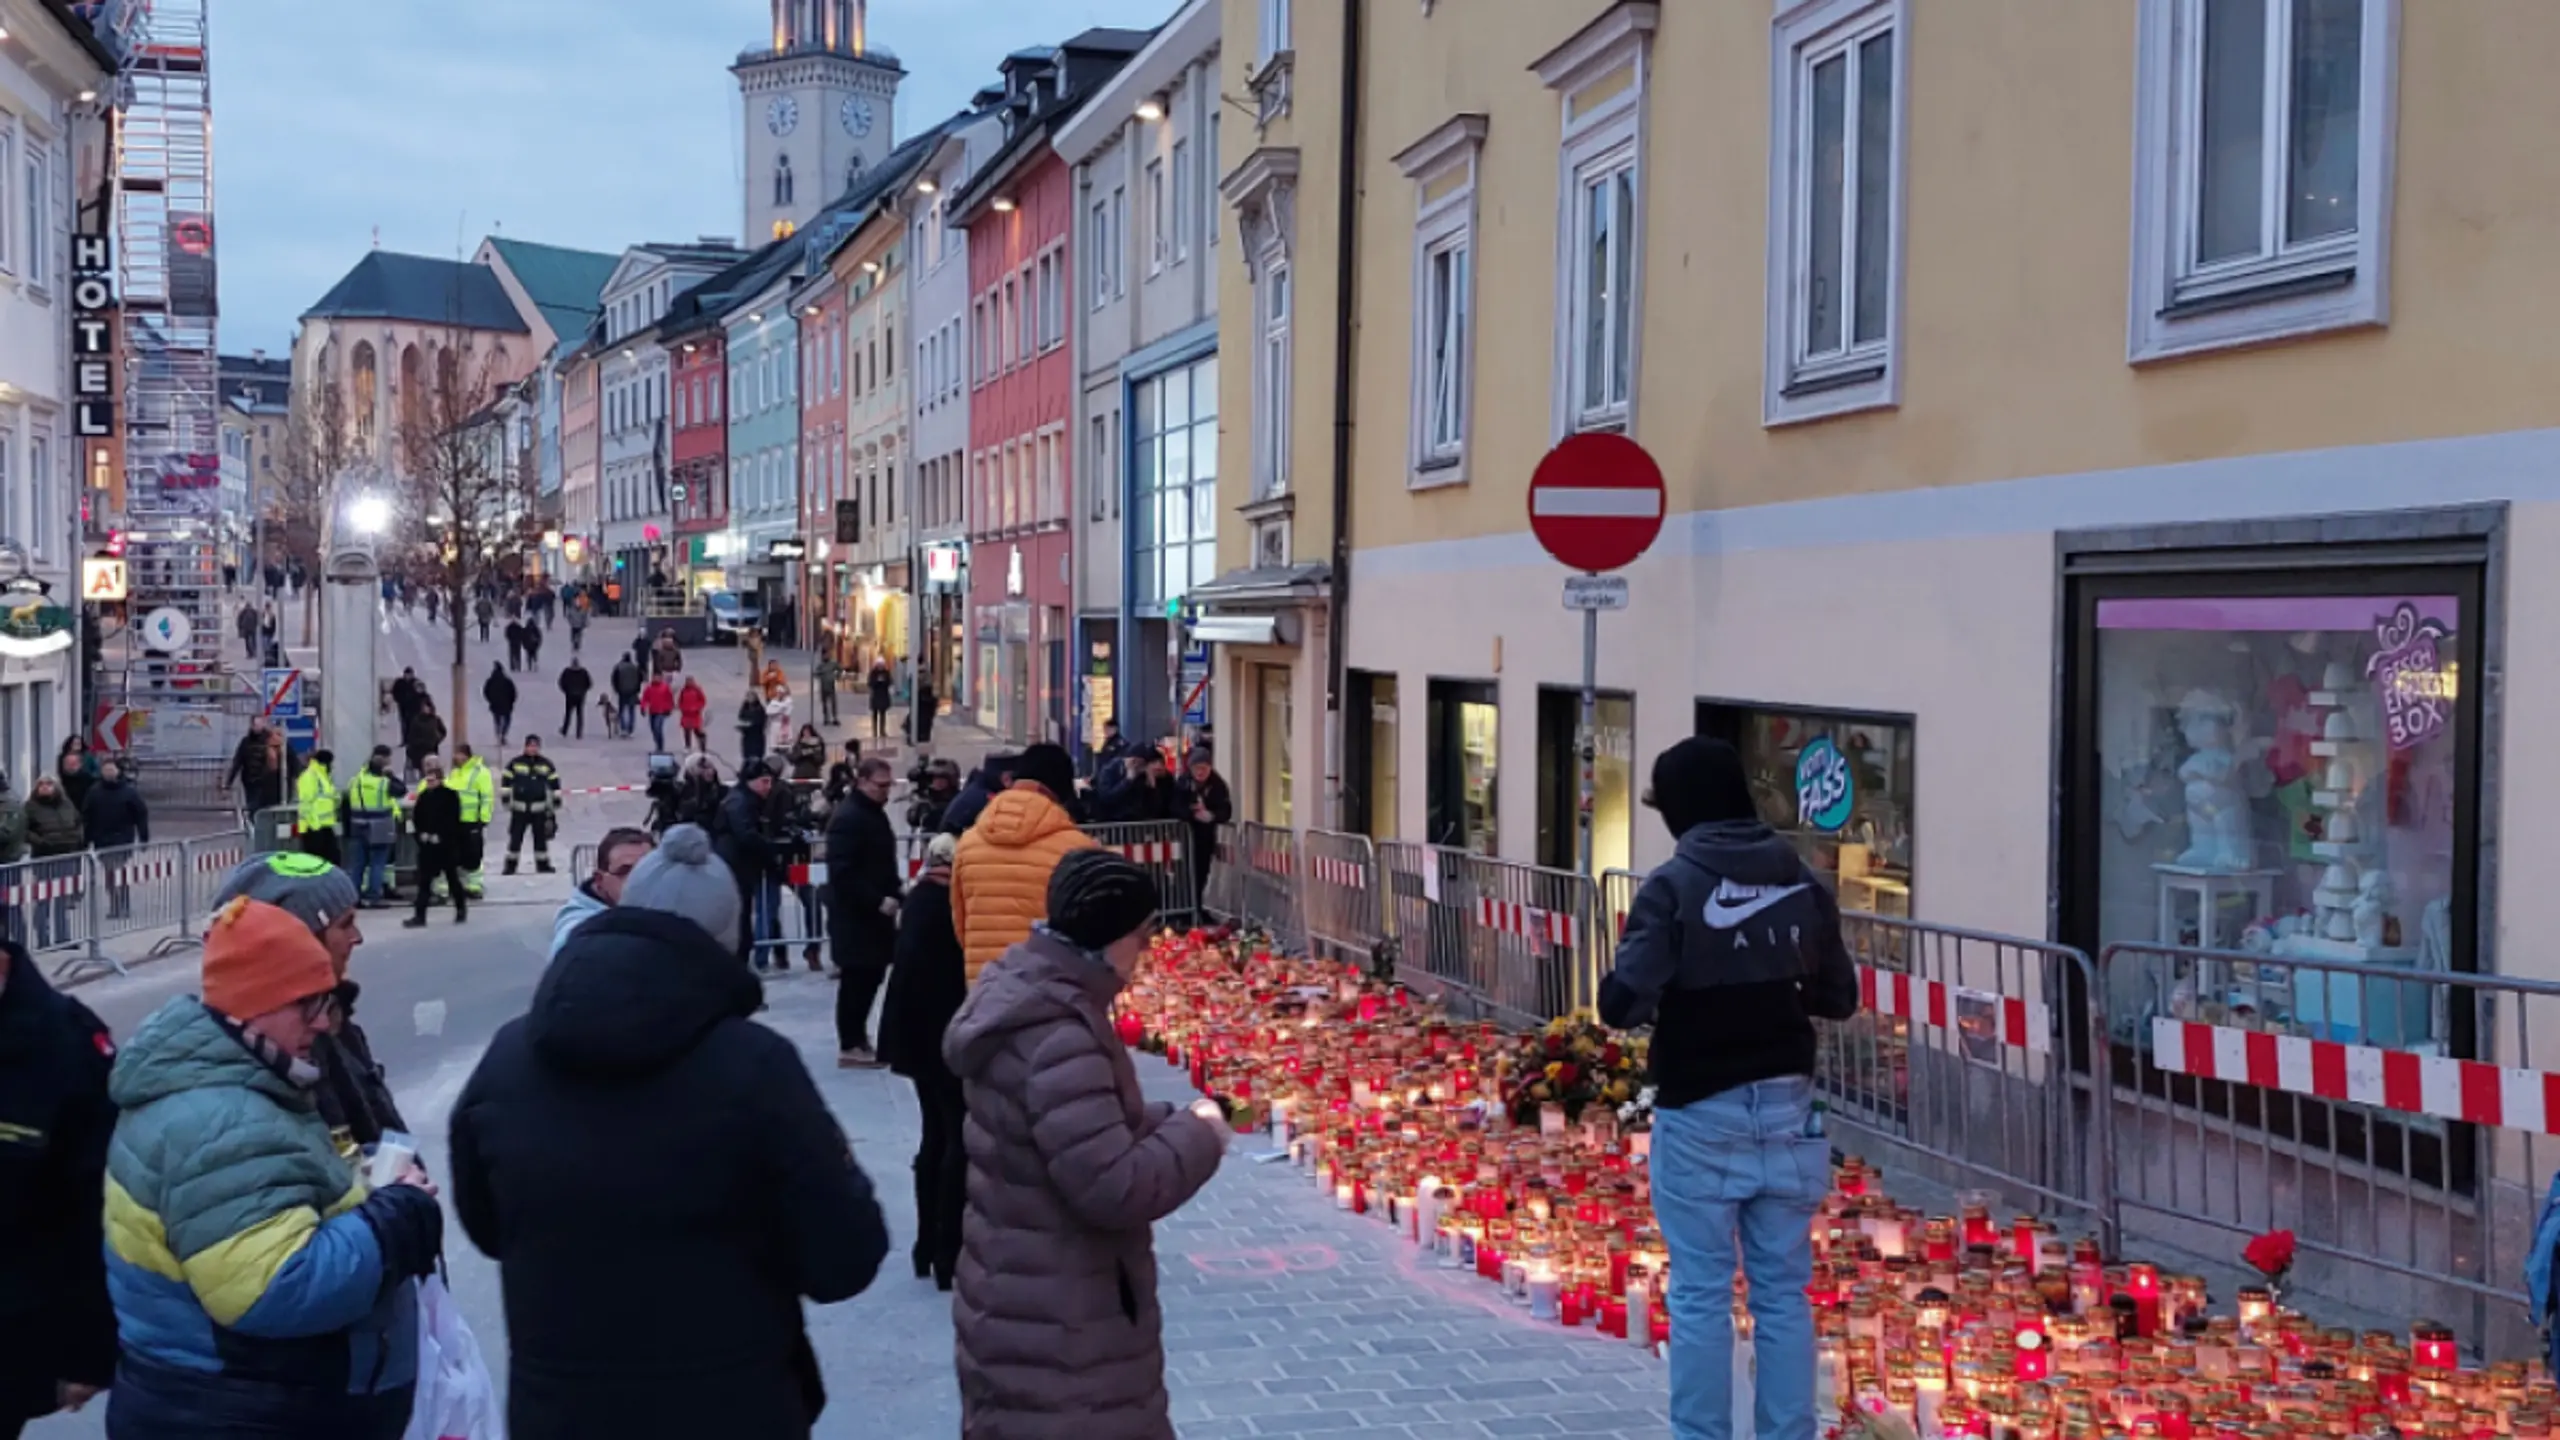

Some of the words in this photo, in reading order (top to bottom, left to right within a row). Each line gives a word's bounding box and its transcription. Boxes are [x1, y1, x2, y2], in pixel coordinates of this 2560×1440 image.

[76, 238, 108, 435] HOTEL
[91, 564, 121, 594] A1
[2381, 648, 2432, 686] GESCH
[2389, 696, 2444, 744] BOX
[1798, 757, 1846, 825] FASS
[1733, 925, 1801, 950] AIR
